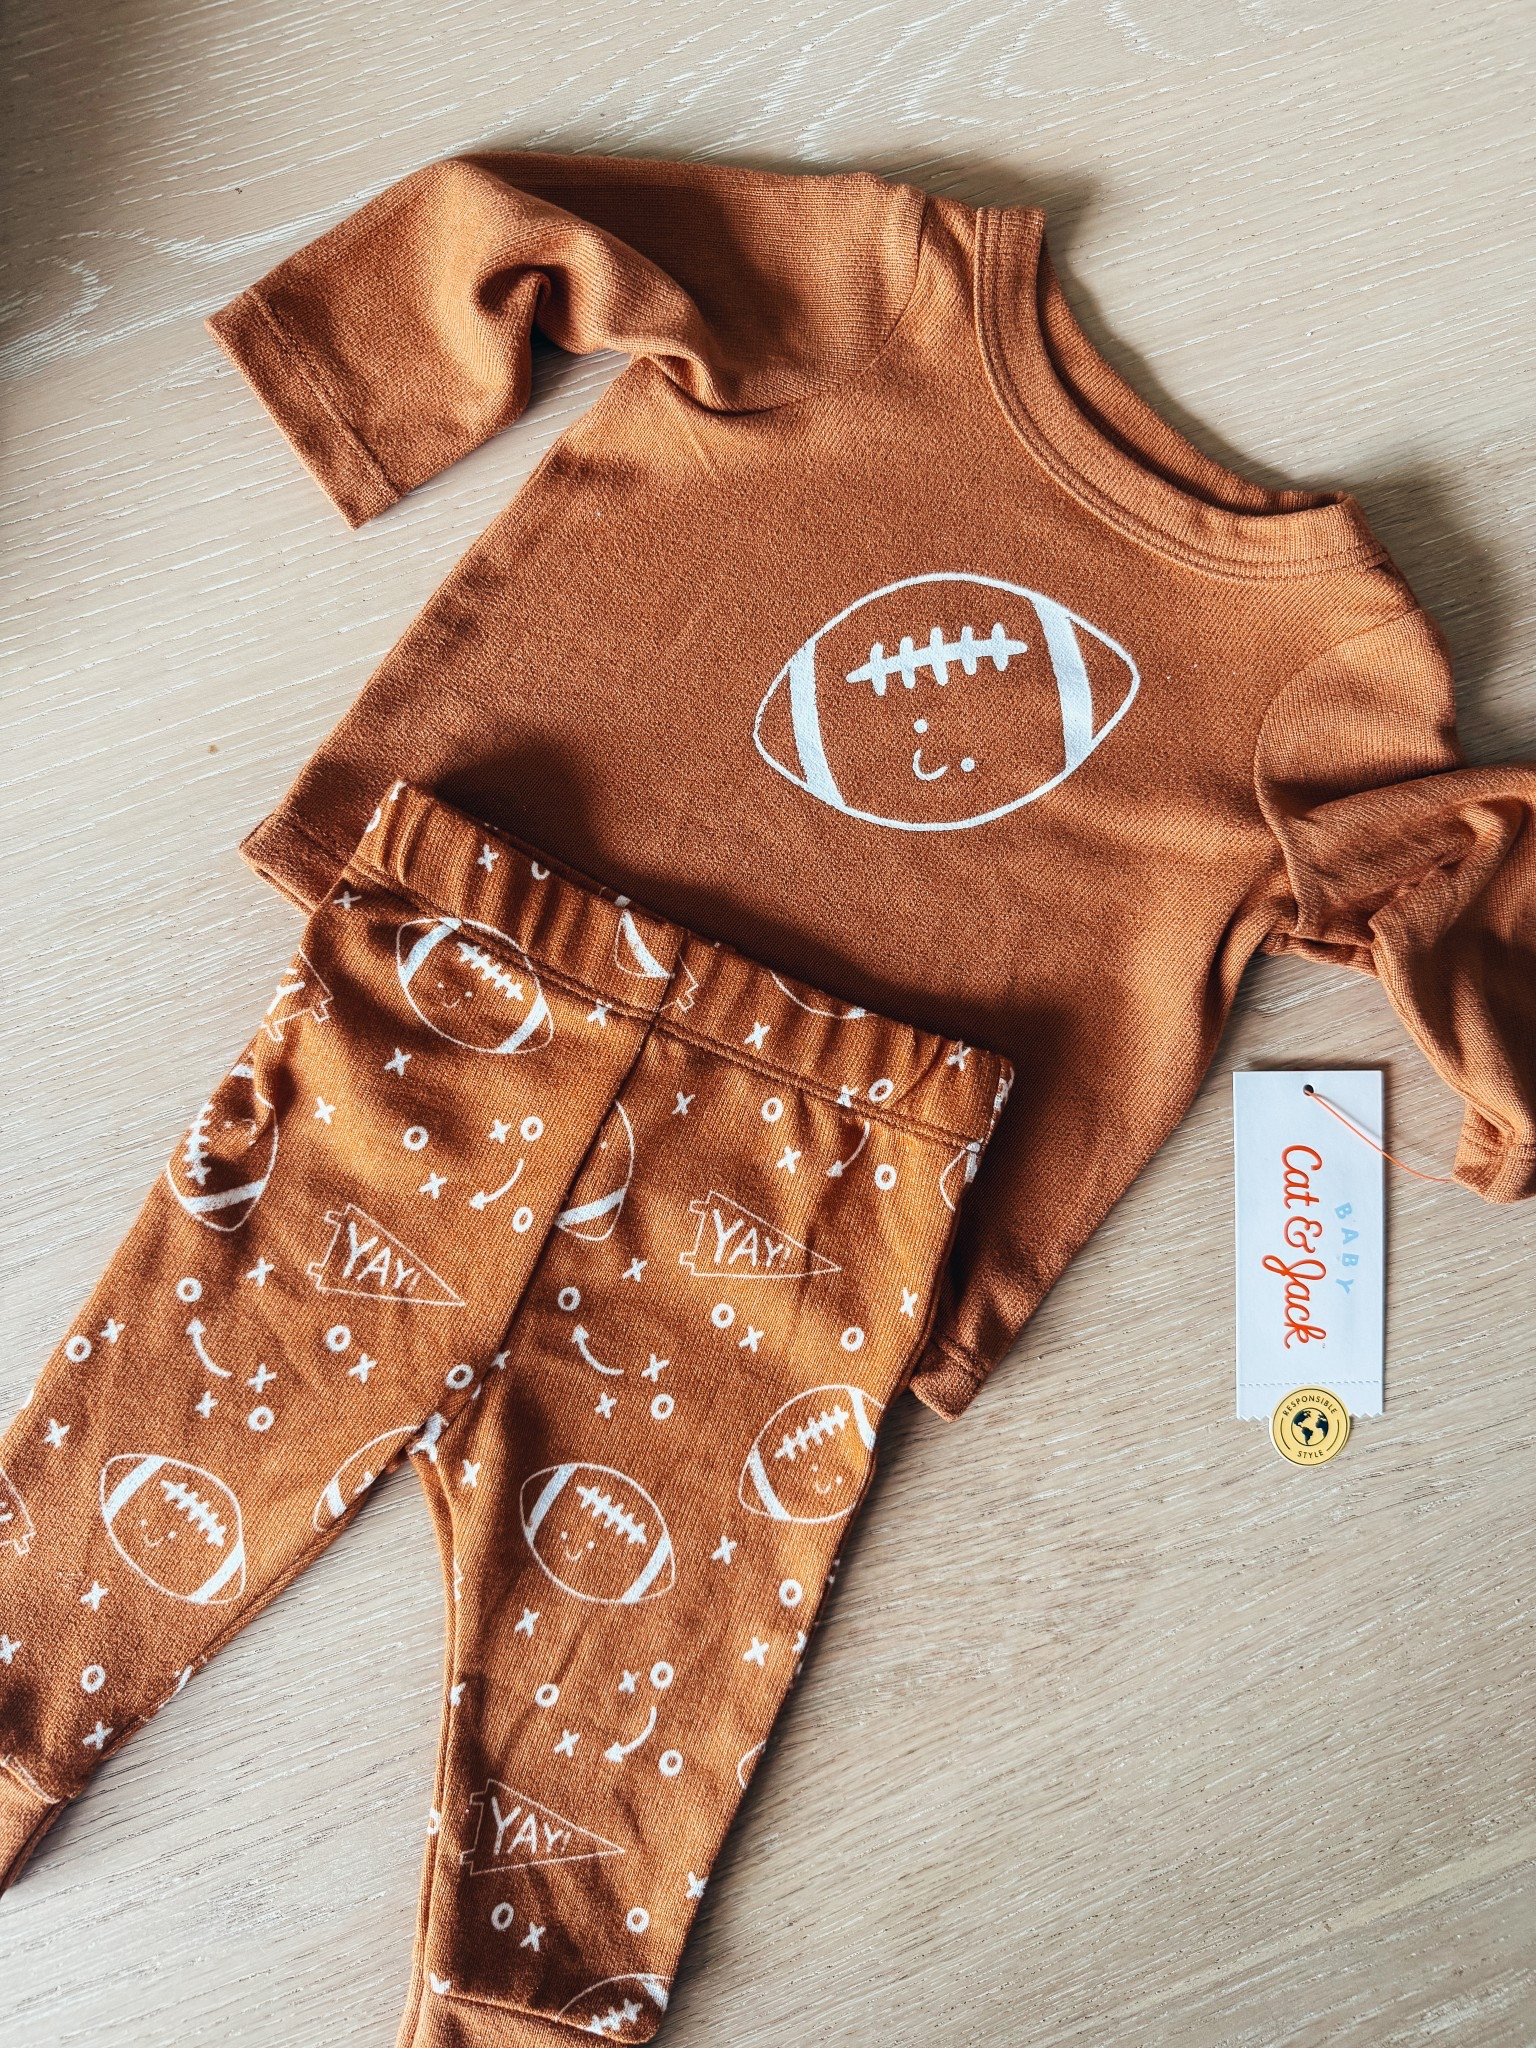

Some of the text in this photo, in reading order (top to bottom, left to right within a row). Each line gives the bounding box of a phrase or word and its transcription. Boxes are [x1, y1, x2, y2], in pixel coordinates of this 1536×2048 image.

[341, 1221, 422, 1294] YAY!
[711, 1208, 793, 1268] YAY!
[1261, 1144, 1327, 1350] Cat & Jack
[1334, 1202, 1360, 1294] BABY
[1282, 1394, 1338, 1417] RESPONSIBLE
[1297, 1449, 1324, 1459] STYLE
[490, 1796, 573, 1857] YAY!
